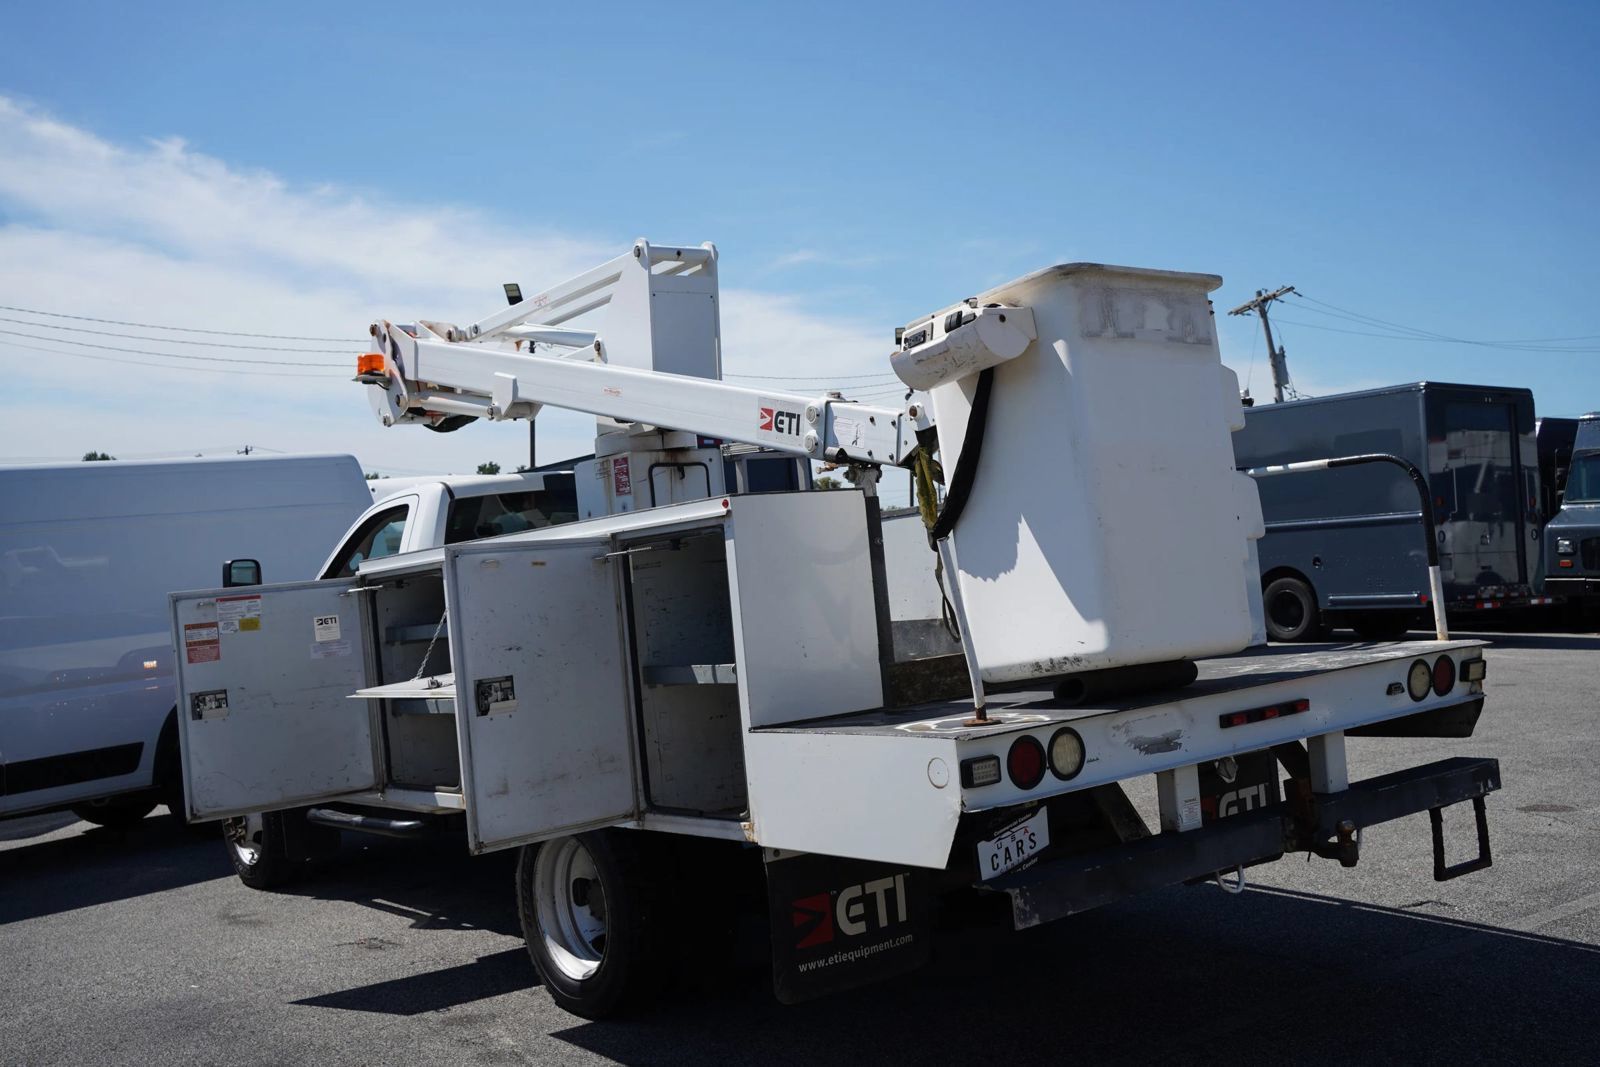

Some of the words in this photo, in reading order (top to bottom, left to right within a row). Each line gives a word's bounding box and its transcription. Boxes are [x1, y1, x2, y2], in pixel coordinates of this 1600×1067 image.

[774, 410, 801, 437] ETI
[323, 616, 337, 625] ETI
[1219, 783, 1267, 819] ETI
[990, 832, 1037, 872] CARS
[835, 873, 908, 936] ETI
[798, 933, 913, 973] www.etiequipment.com
